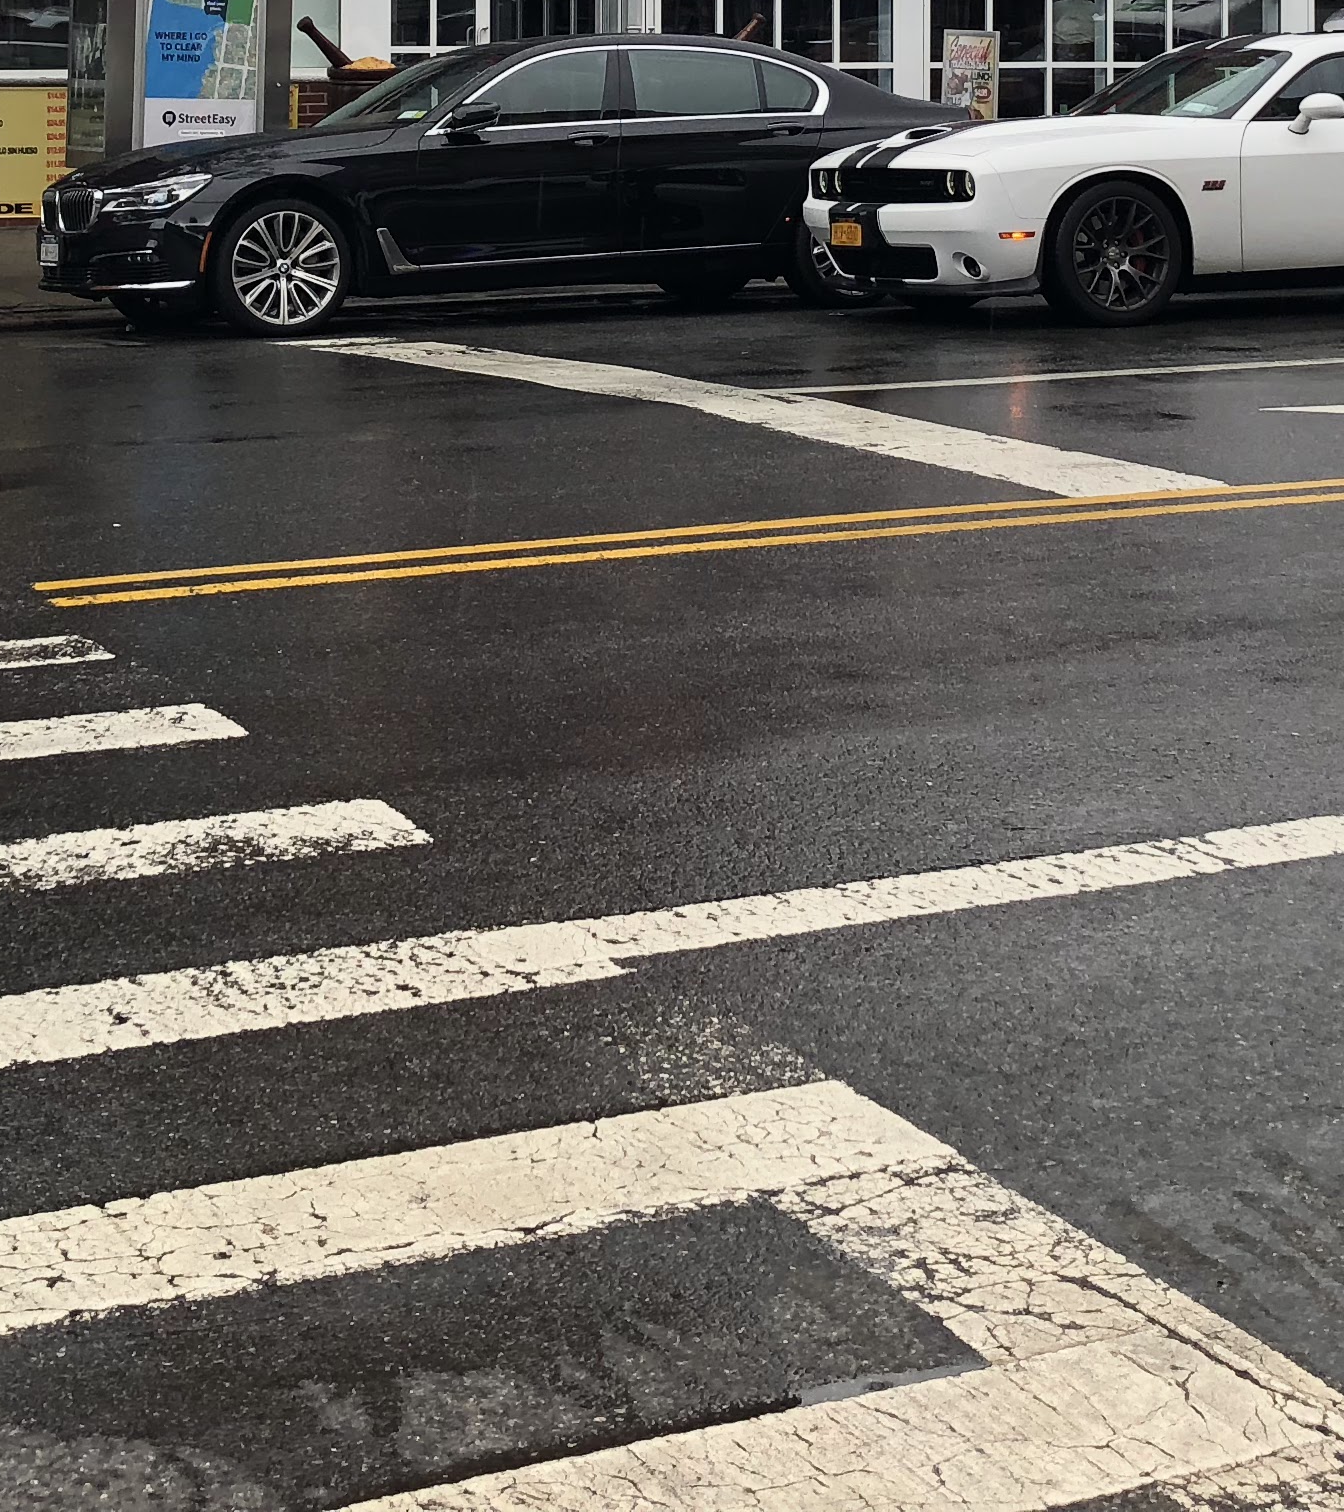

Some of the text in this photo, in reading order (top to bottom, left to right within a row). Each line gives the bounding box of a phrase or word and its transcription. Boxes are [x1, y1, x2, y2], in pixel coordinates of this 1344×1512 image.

[155, 31, 208, 41] WHERE GO
[160, 42, 203, 52] TO CLEAR
[161, 53, 201, 63] MY MIND
[178, 112, 237, 127] StreetEasy
